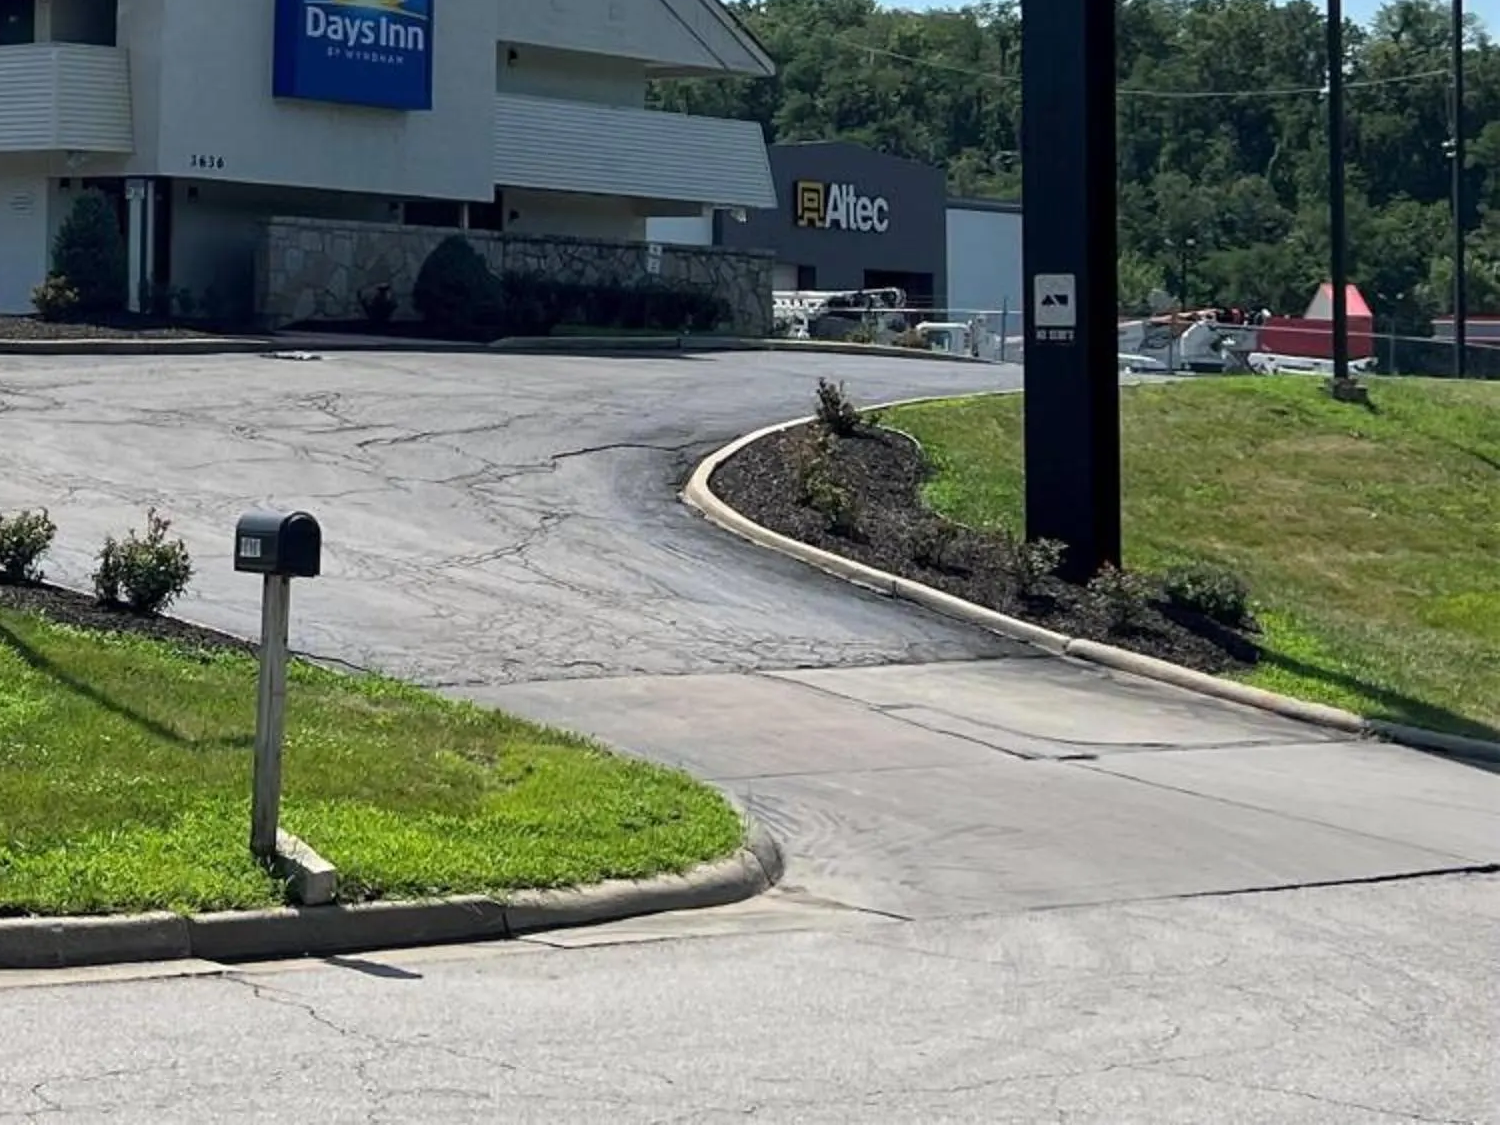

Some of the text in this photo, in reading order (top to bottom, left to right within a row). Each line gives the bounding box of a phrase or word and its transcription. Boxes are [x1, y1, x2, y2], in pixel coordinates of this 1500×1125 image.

[305, 6, 425, 51] Days Inn
[344, 50, 404, 64] WYNDHAM
[825, 181, 889, 232] Altec
